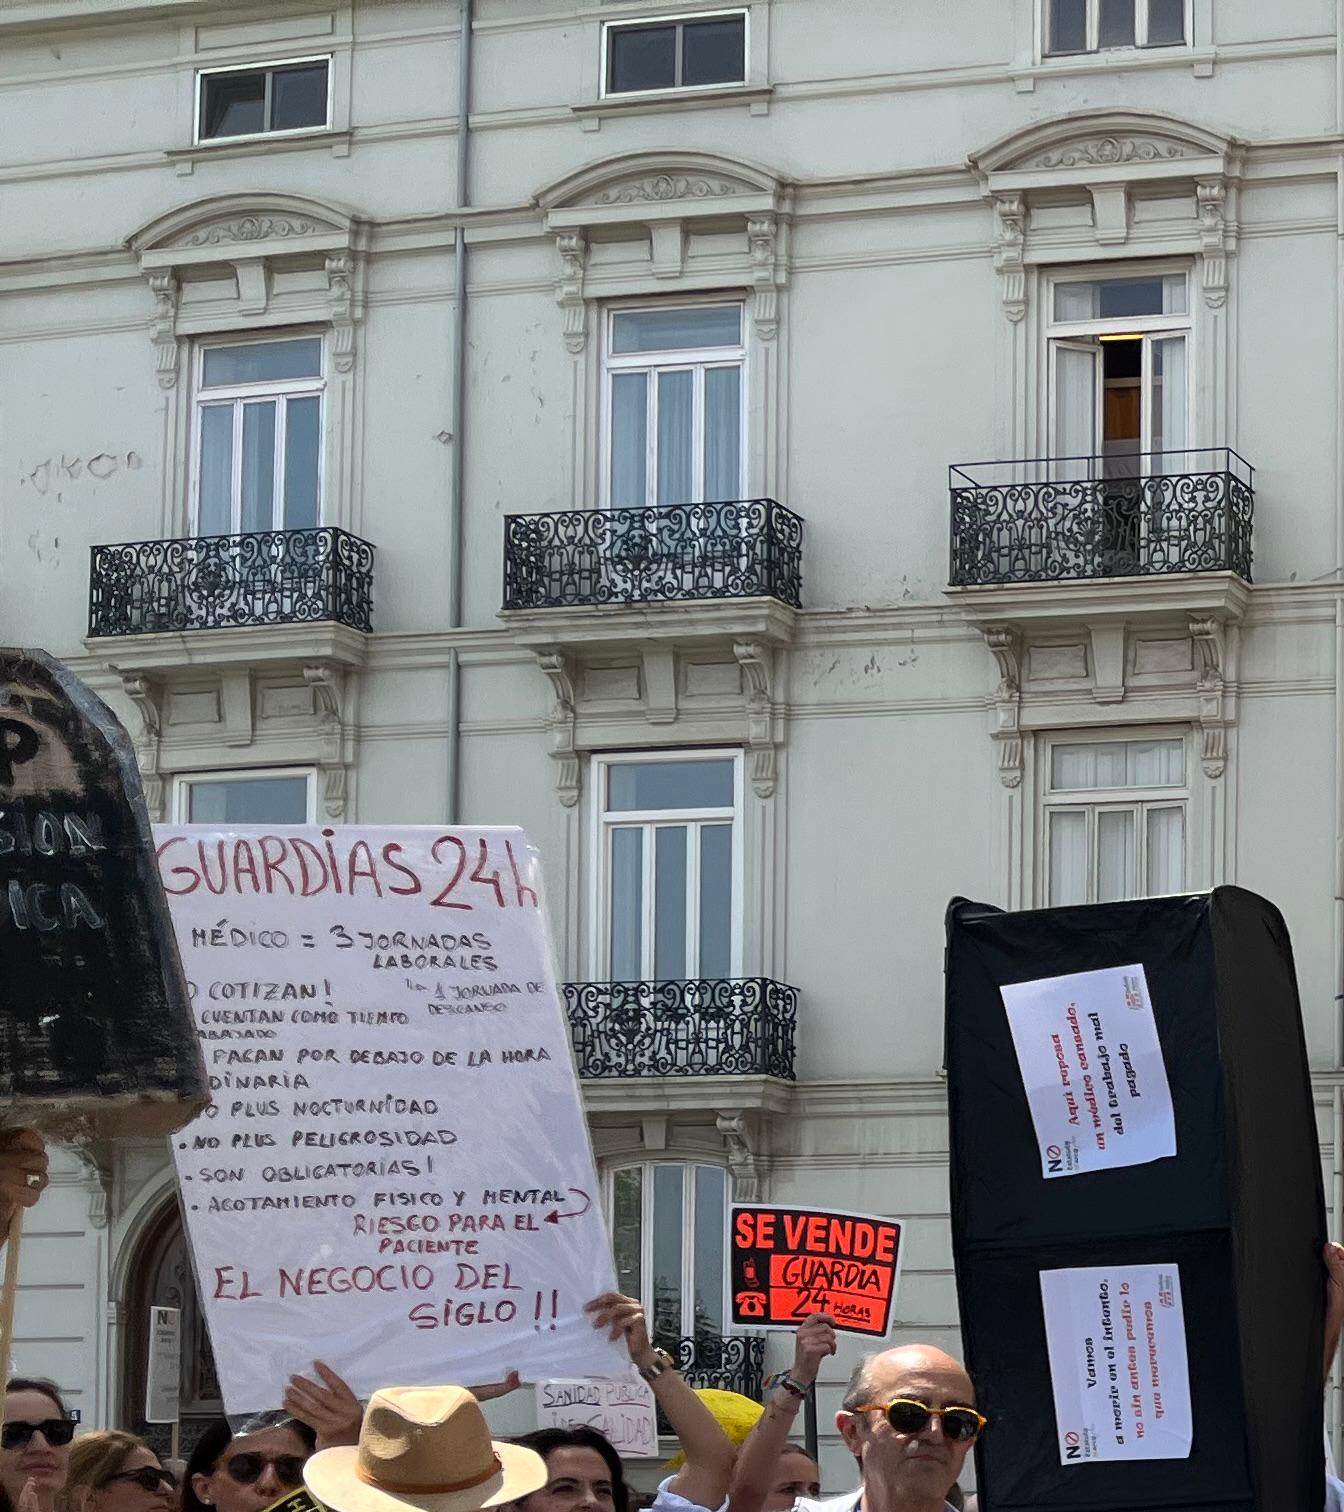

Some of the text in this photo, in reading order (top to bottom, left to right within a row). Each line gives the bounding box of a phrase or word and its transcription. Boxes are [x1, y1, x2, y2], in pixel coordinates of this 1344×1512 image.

[157, 829, 538, 909] GUARDIAS 24h
[192, 919, 491, 949] MÉDICO 3 JORNADAS
[373, 954, 498, 971] LABORALES
[213, 1047, 551, 1067] PAGAN POR DEBAJO DE LA HORA
[1118, 1043, 1142, 1099] pagado
[231, 1094, 438, 1117] PLUS NOCTURNIDAD
[193, 1129, 458, 1151] NO PLUS PELIGROSIDAD
[200, 1167, 244, 1183] SON
[208, 1187, 566, 1213] AGOTAMIENTO FISICO Y MENTAL
[354, 1213, 539, 1238] RIESGO PARA EL
[735, 1212, 898, 1264] SE VENDE
[379, 1239, 479, 1256] PACIENTE
[215, 1263, 523, 1300] EL NEGOCIO DEL
[782, 1256, 881, 1292] GUARDIA
[409, 1298, 517, 1330] SIGLO
[791, 1285, 872, 1320] 24 HORAS
[1084, 1337, 1098, 1389] Vamos
